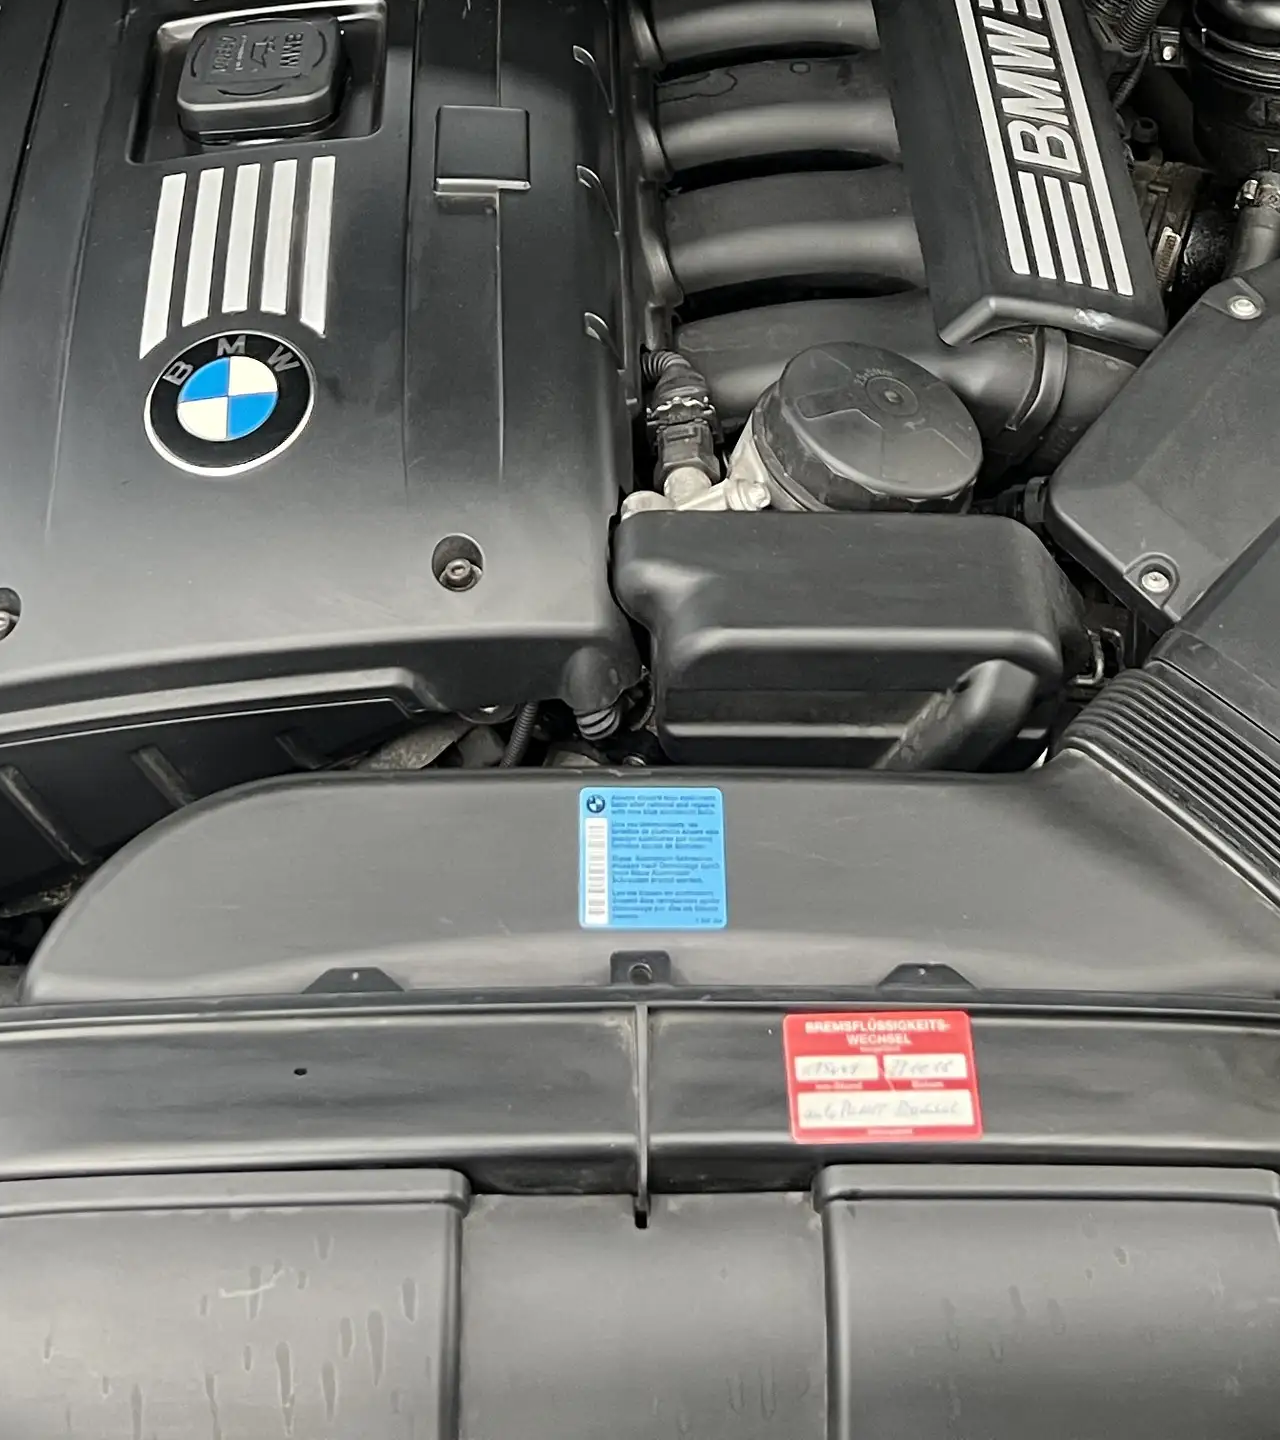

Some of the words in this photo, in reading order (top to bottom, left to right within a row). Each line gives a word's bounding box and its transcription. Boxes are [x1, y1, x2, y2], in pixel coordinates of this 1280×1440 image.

[981, 15, 1083, 176] BMW
[162, 335, 300, 386] BMW
[846, 1033, 913, 1046] WECHSEL
